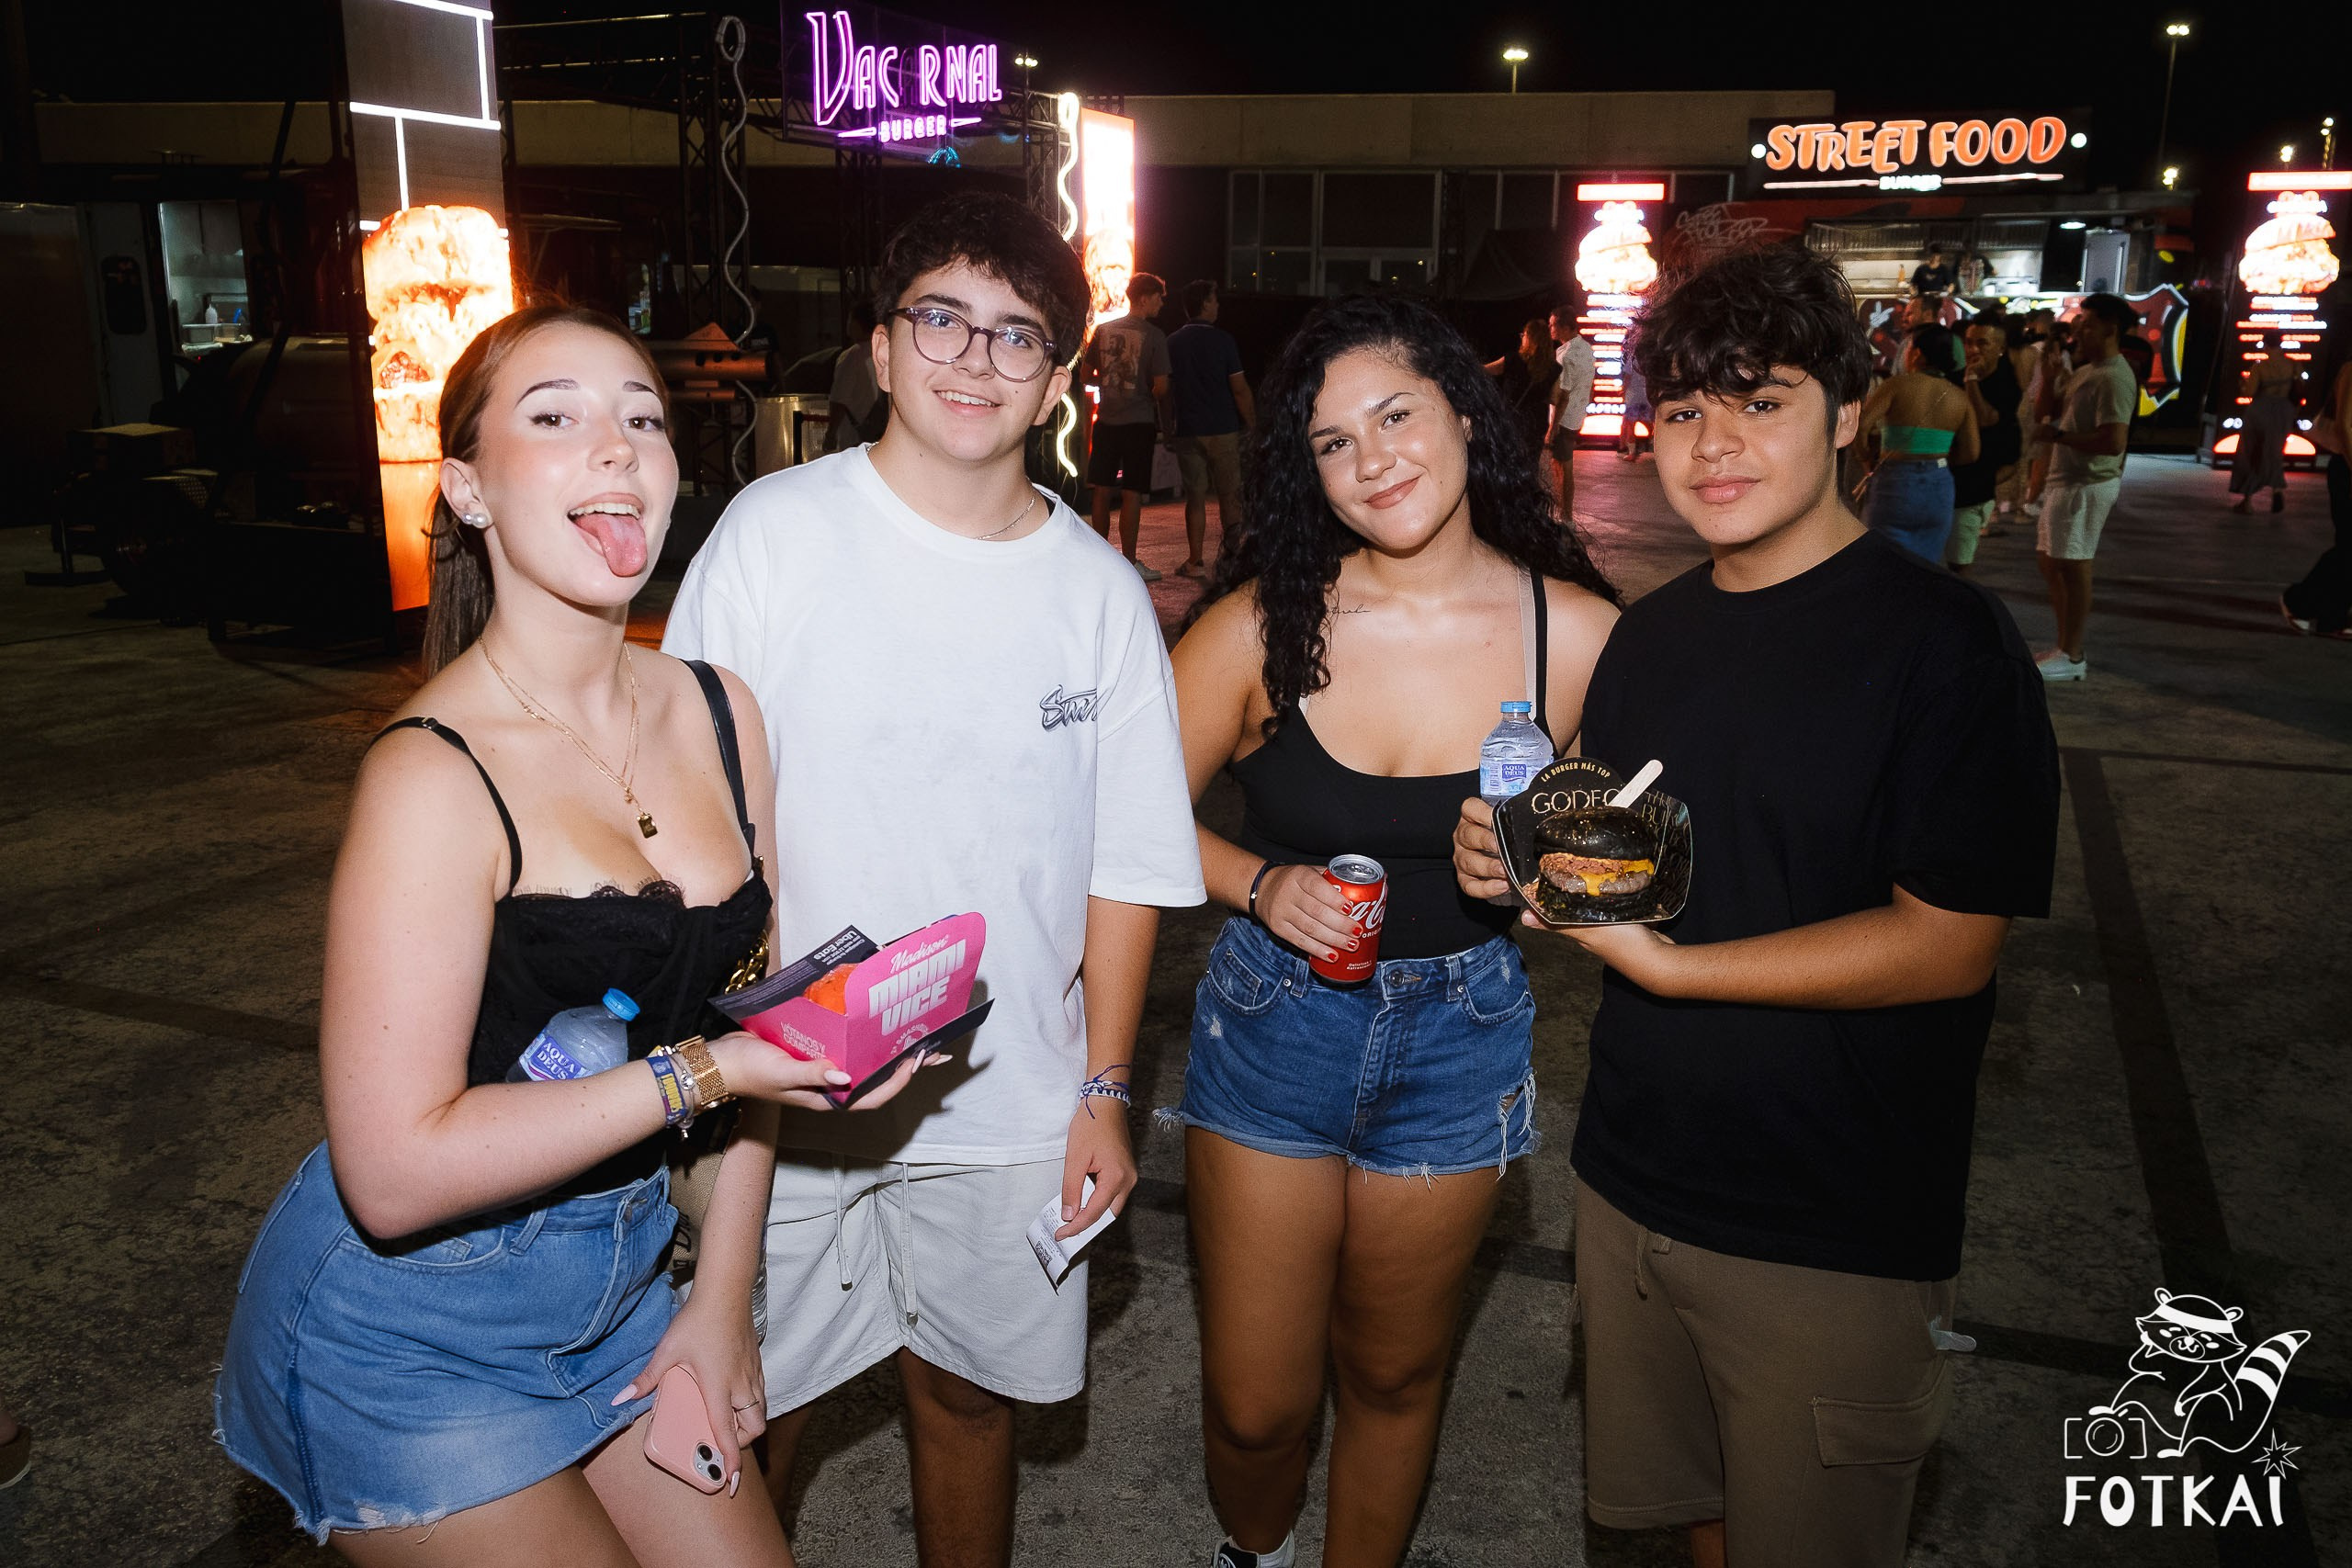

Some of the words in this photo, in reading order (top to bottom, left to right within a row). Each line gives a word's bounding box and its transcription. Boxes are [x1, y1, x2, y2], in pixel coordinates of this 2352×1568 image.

[879, 115, 947, 142] BURGER
[1766, 120, 1927, 174] STREET
[1929, 116, 2067, 167] FOOD
[1541, 773, 1551, 783] LA
[1551, 762, 1578, 776] BURGER
[1581, 761, 1596, 772] MÁS
[1597, 767, 1611, 778] TOP
[813, 943, 837, 960] Eats
[835, 931, 858, 947] Uber
[890, 935, 948, 974] Madison
[869, 938, 967, 1019] MIAMI
[881, 975, 950, 1036] VICE
[537, 1051, 568, 1079] DEUS
[543, 1043, 575, 1073] AQUA
